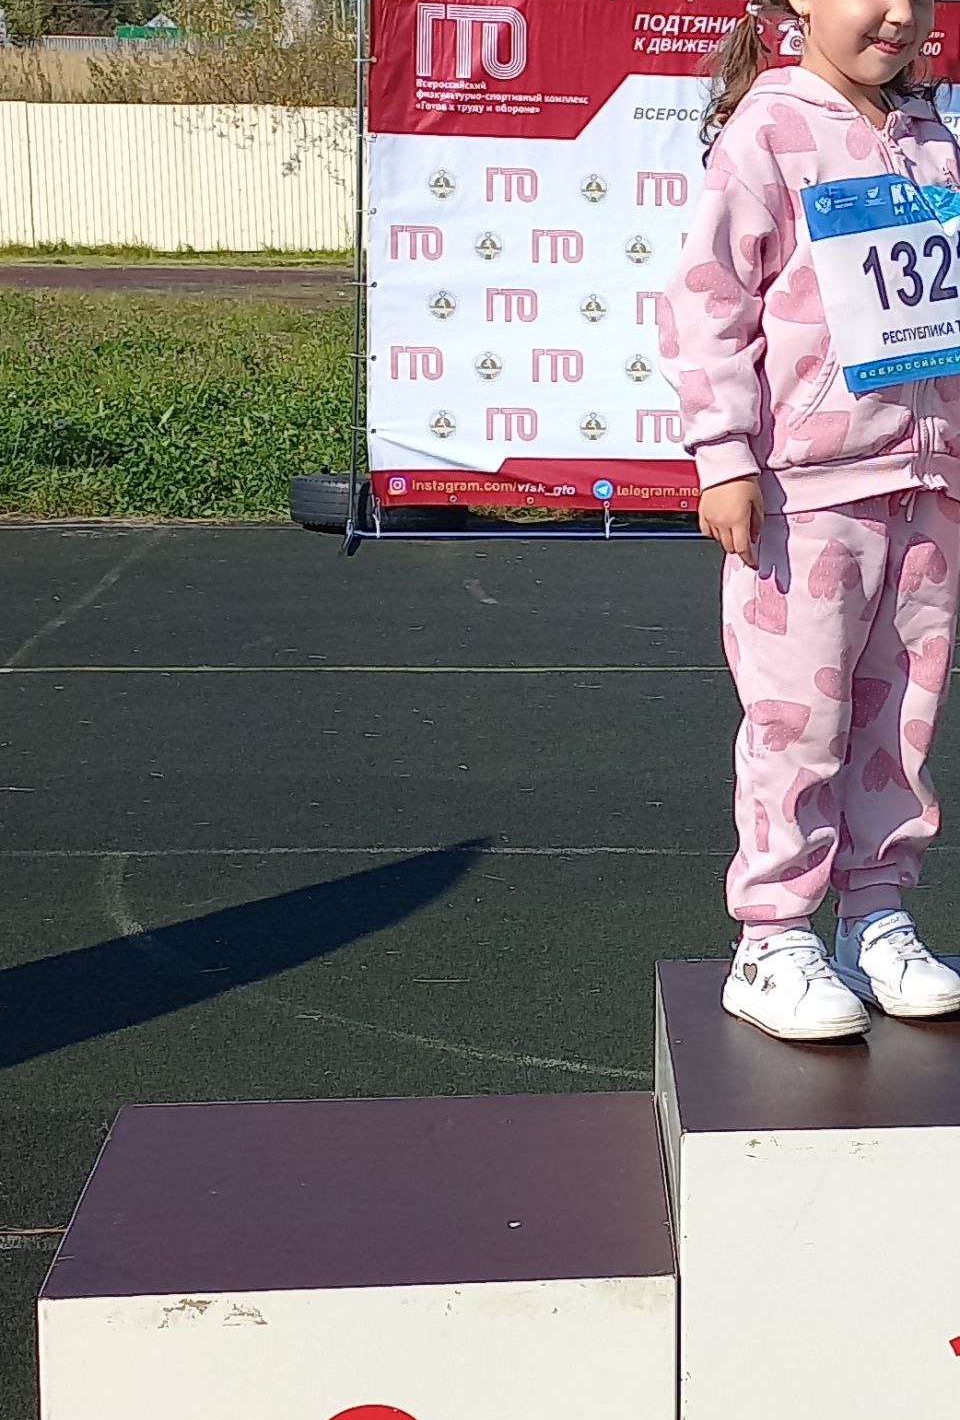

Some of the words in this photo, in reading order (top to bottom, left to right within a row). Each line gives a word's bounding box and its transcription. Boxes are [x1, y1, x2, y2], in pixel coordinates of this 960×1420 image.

[416, 2, 527, 79] ГТО
[634, 14, 763, 36] ПОДТЯНИ
[634, 37, 646, 51] К
[416, 79, 487, 91] Всероссийский
[416, 89, 542, 103] физкультурно-спортивный
[544, 95, 589, 105] комплекс
[457, 103, 484, 114] труду
[486, 167, 538, 202] ГТО
[636, 172, 688, 206] ГТО
[390, 225, 443, 260] ГТО
[532, 230, 583, 263] ГТО
[486, 288, 538, 322] ГТО
[882, 322, 954, 346] РЕСПУБЛИКА
[390, 346, 443, 380] ГТО
[532, 349, 583, 382] ГТО
[486, 407, 538, 441] ГТО
[616, 485, 700, 499] telegram.me
